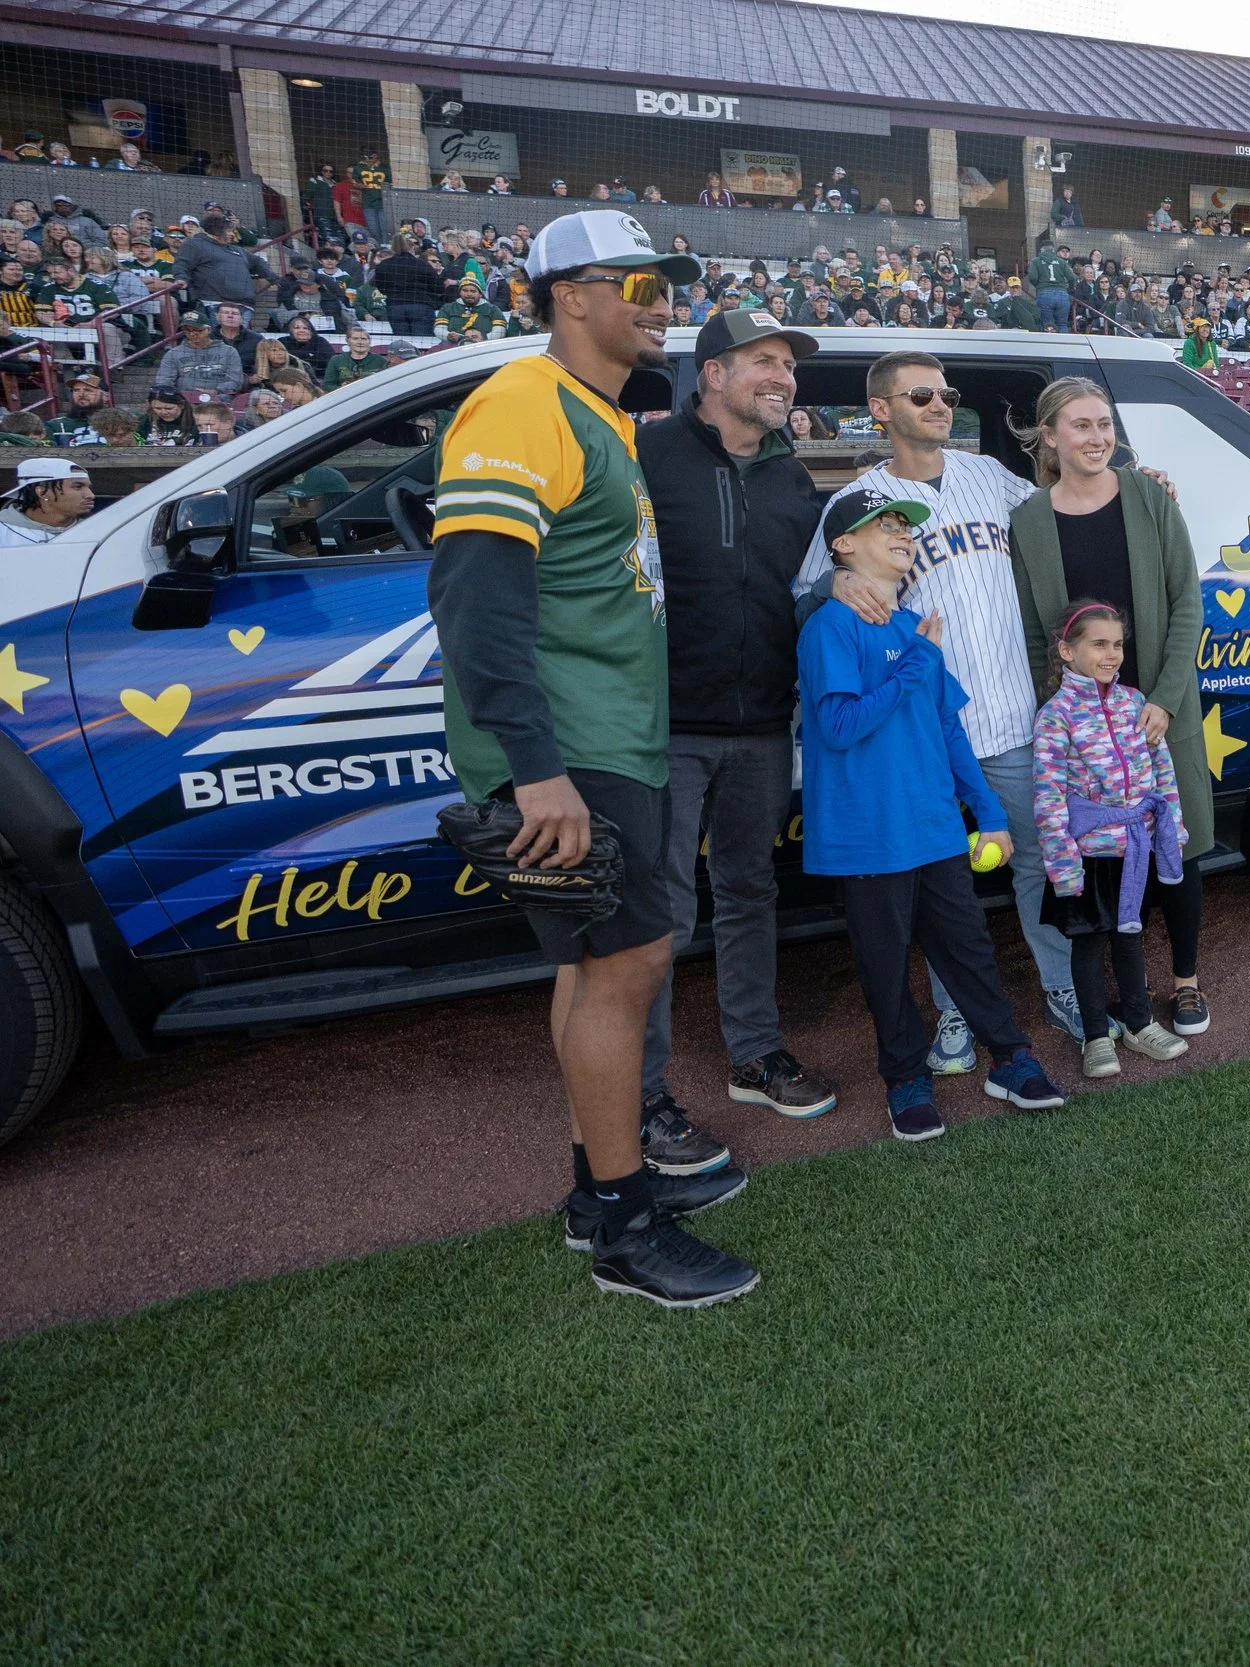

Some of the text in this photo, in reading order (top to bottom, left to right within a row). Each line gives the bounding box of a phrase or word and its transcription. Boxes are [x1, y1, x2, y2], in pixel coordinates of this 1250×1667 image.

[112, 118, 144, 130] PEPSI
[1235, 145, 1250, 156] 109
[360, 170, 386, 190] 23
[1047, 264, 1056, 281] 1
[508, 872, 568, 887] MIZUNO
[216, 860, 412, 941] Help
